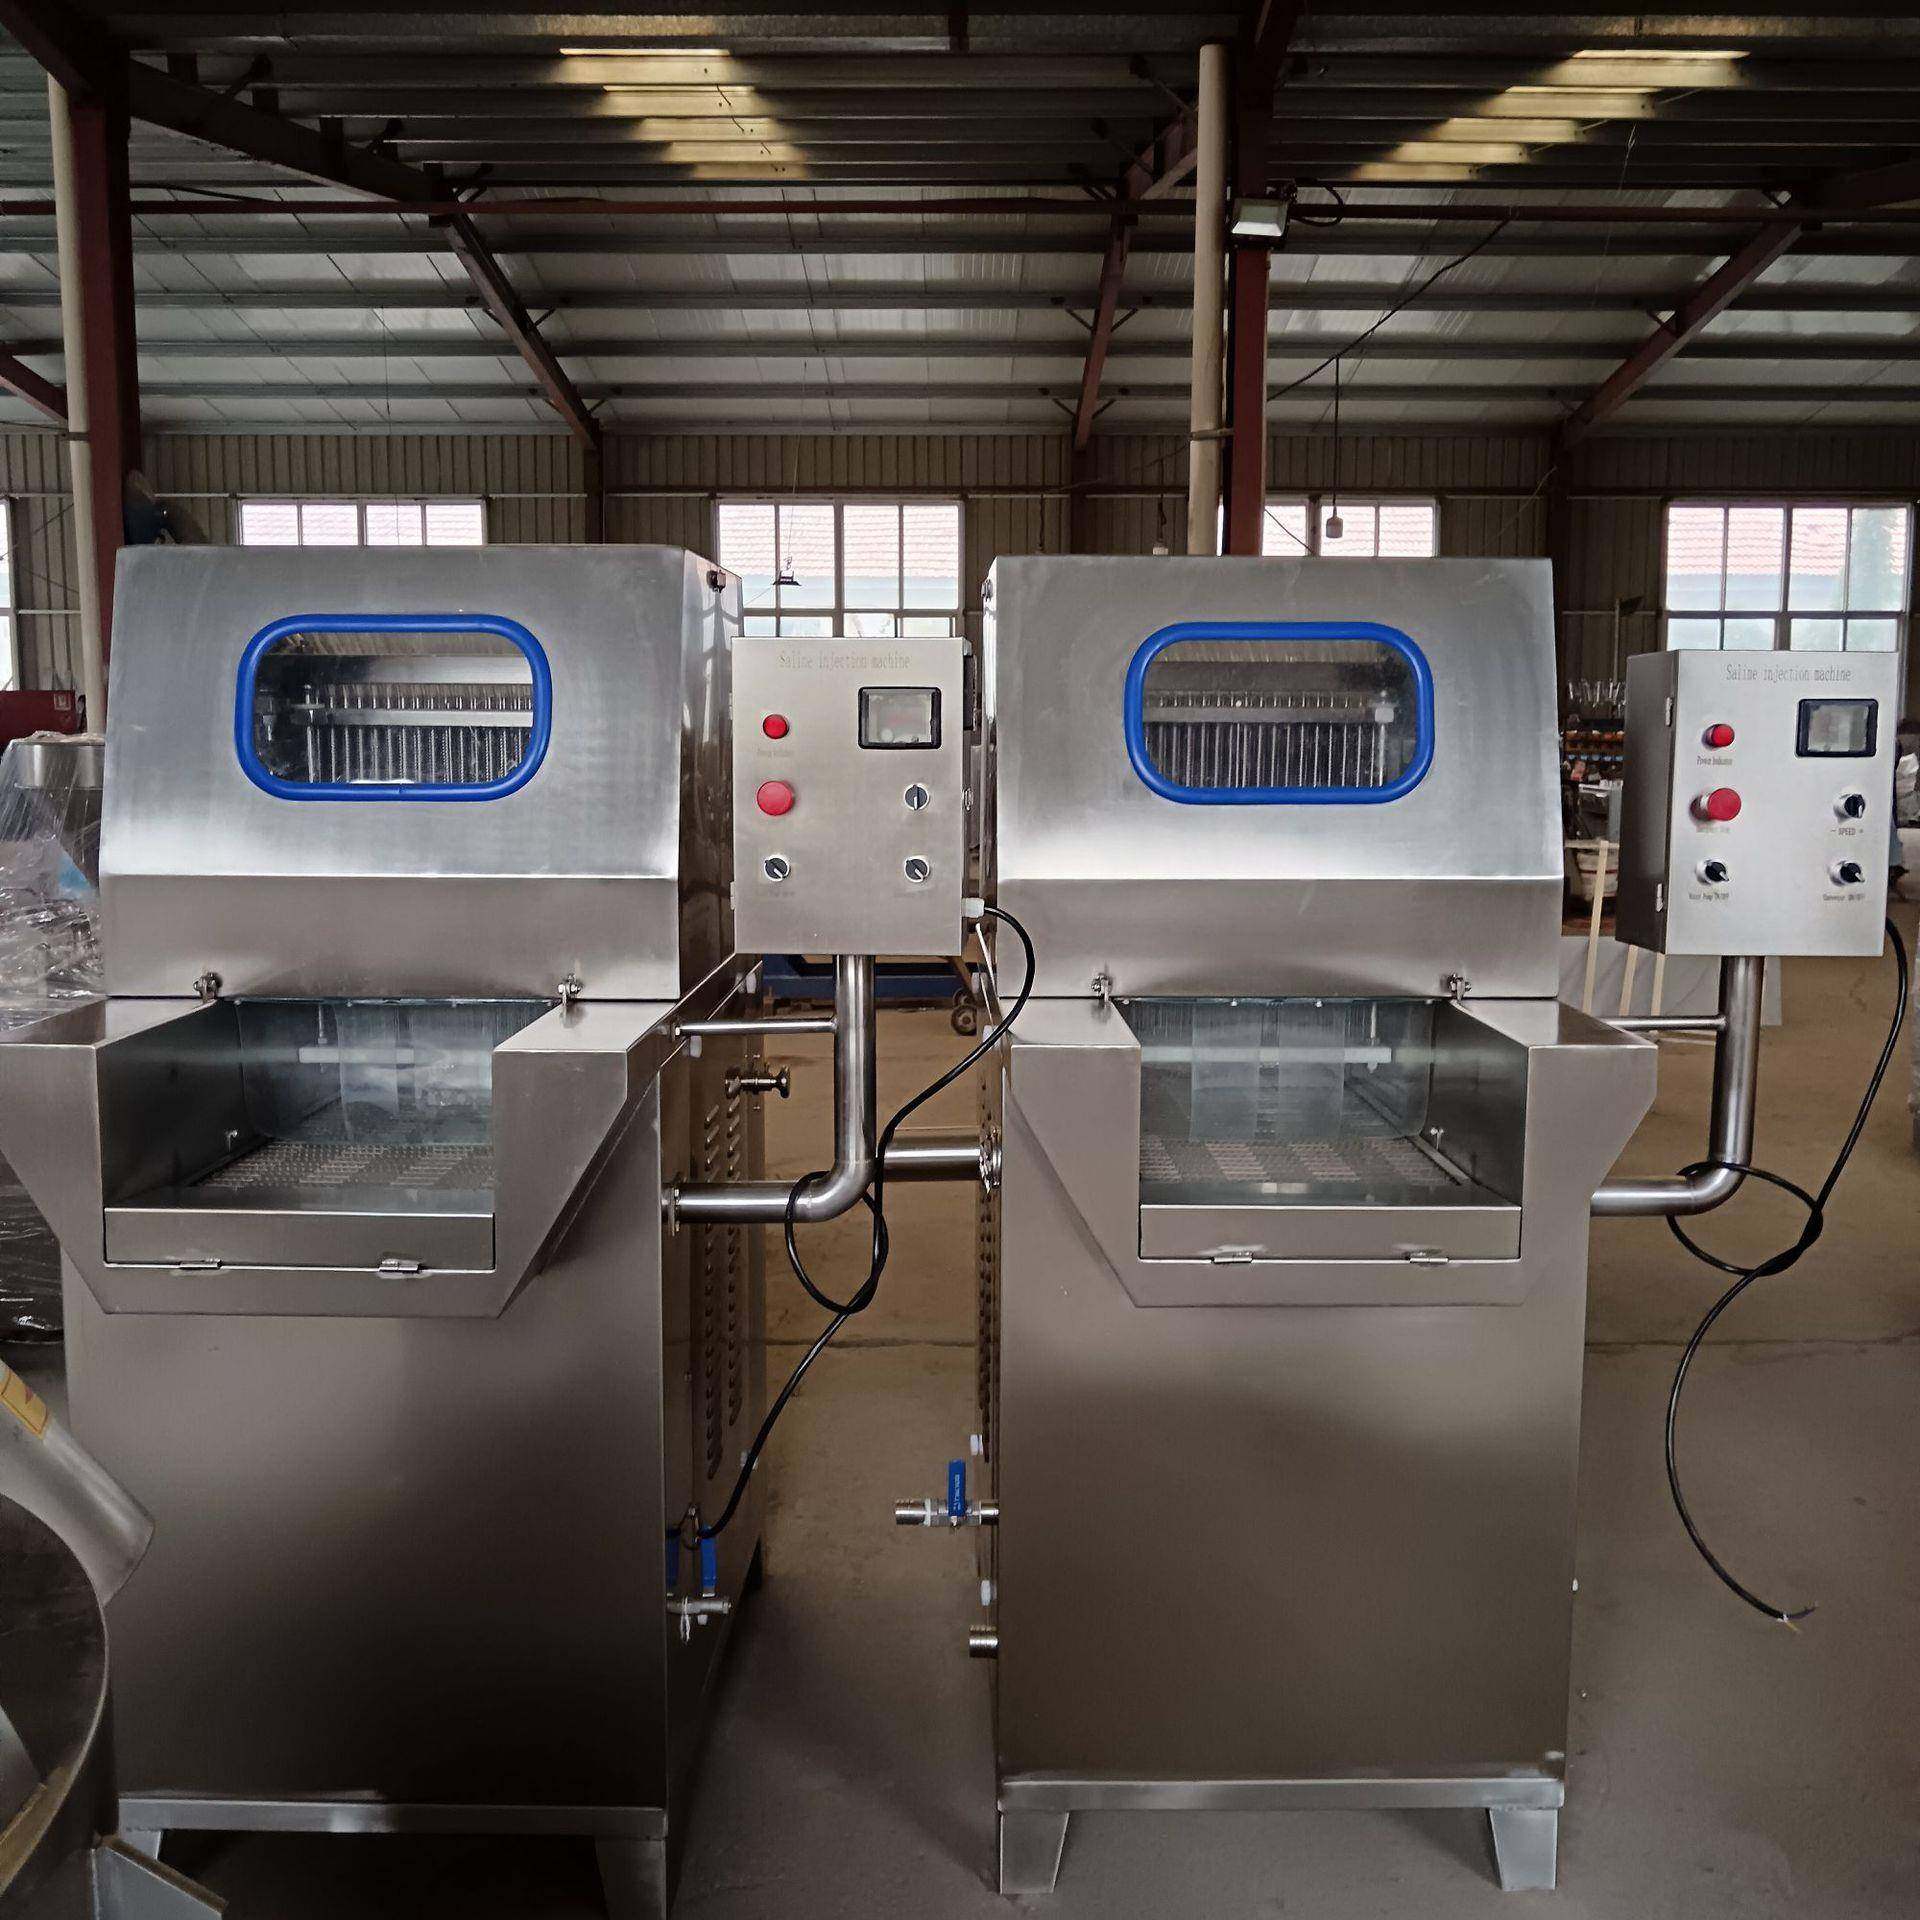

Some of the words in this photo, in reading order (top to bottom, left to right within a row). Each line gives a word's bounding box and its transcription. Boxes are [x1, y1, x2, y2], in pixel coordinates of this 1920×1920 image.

[819, 650, 867, 671] injection
[871, 650, 911, 669] machine
[1726, 664, 1758, 681] Saline
[1763, 664, 1809, 683] injection
[1814, 664, 1852, 681] machine
[1839, 827, 1856, 836] SPEED
